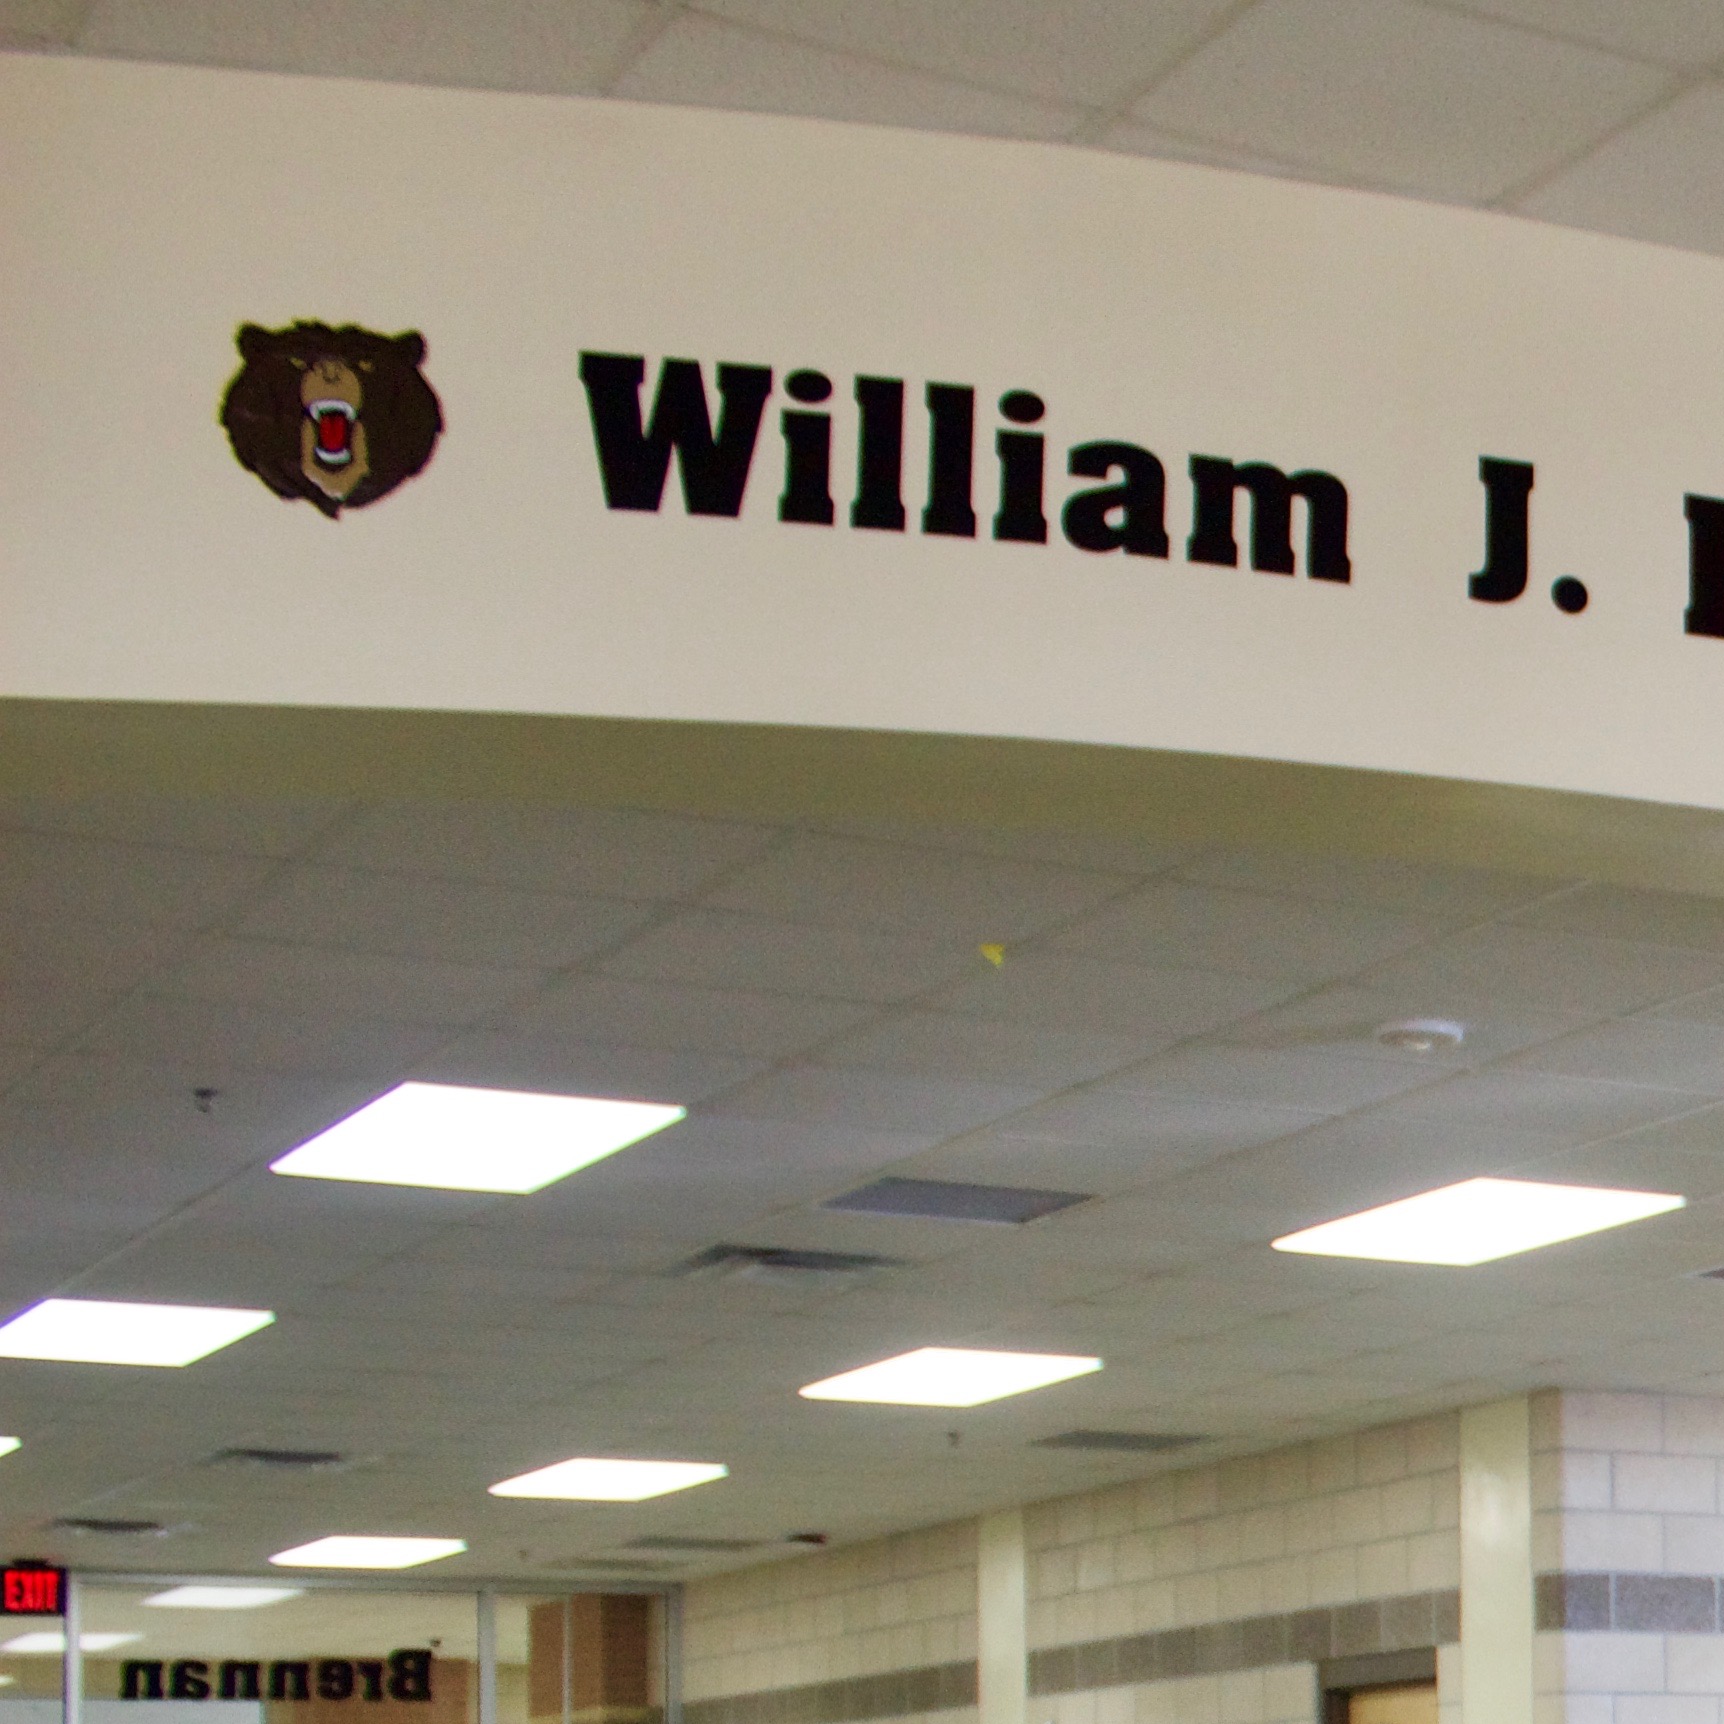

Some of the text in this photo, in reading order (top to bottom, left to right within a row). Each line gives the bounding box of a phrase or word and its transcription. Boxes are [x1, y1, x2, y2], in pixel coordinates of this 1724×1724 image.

[579, 351, 1352, 585] William
[1468, 456, 1589, 614] J.
[4, 1569, 58, 1612] EXIT
